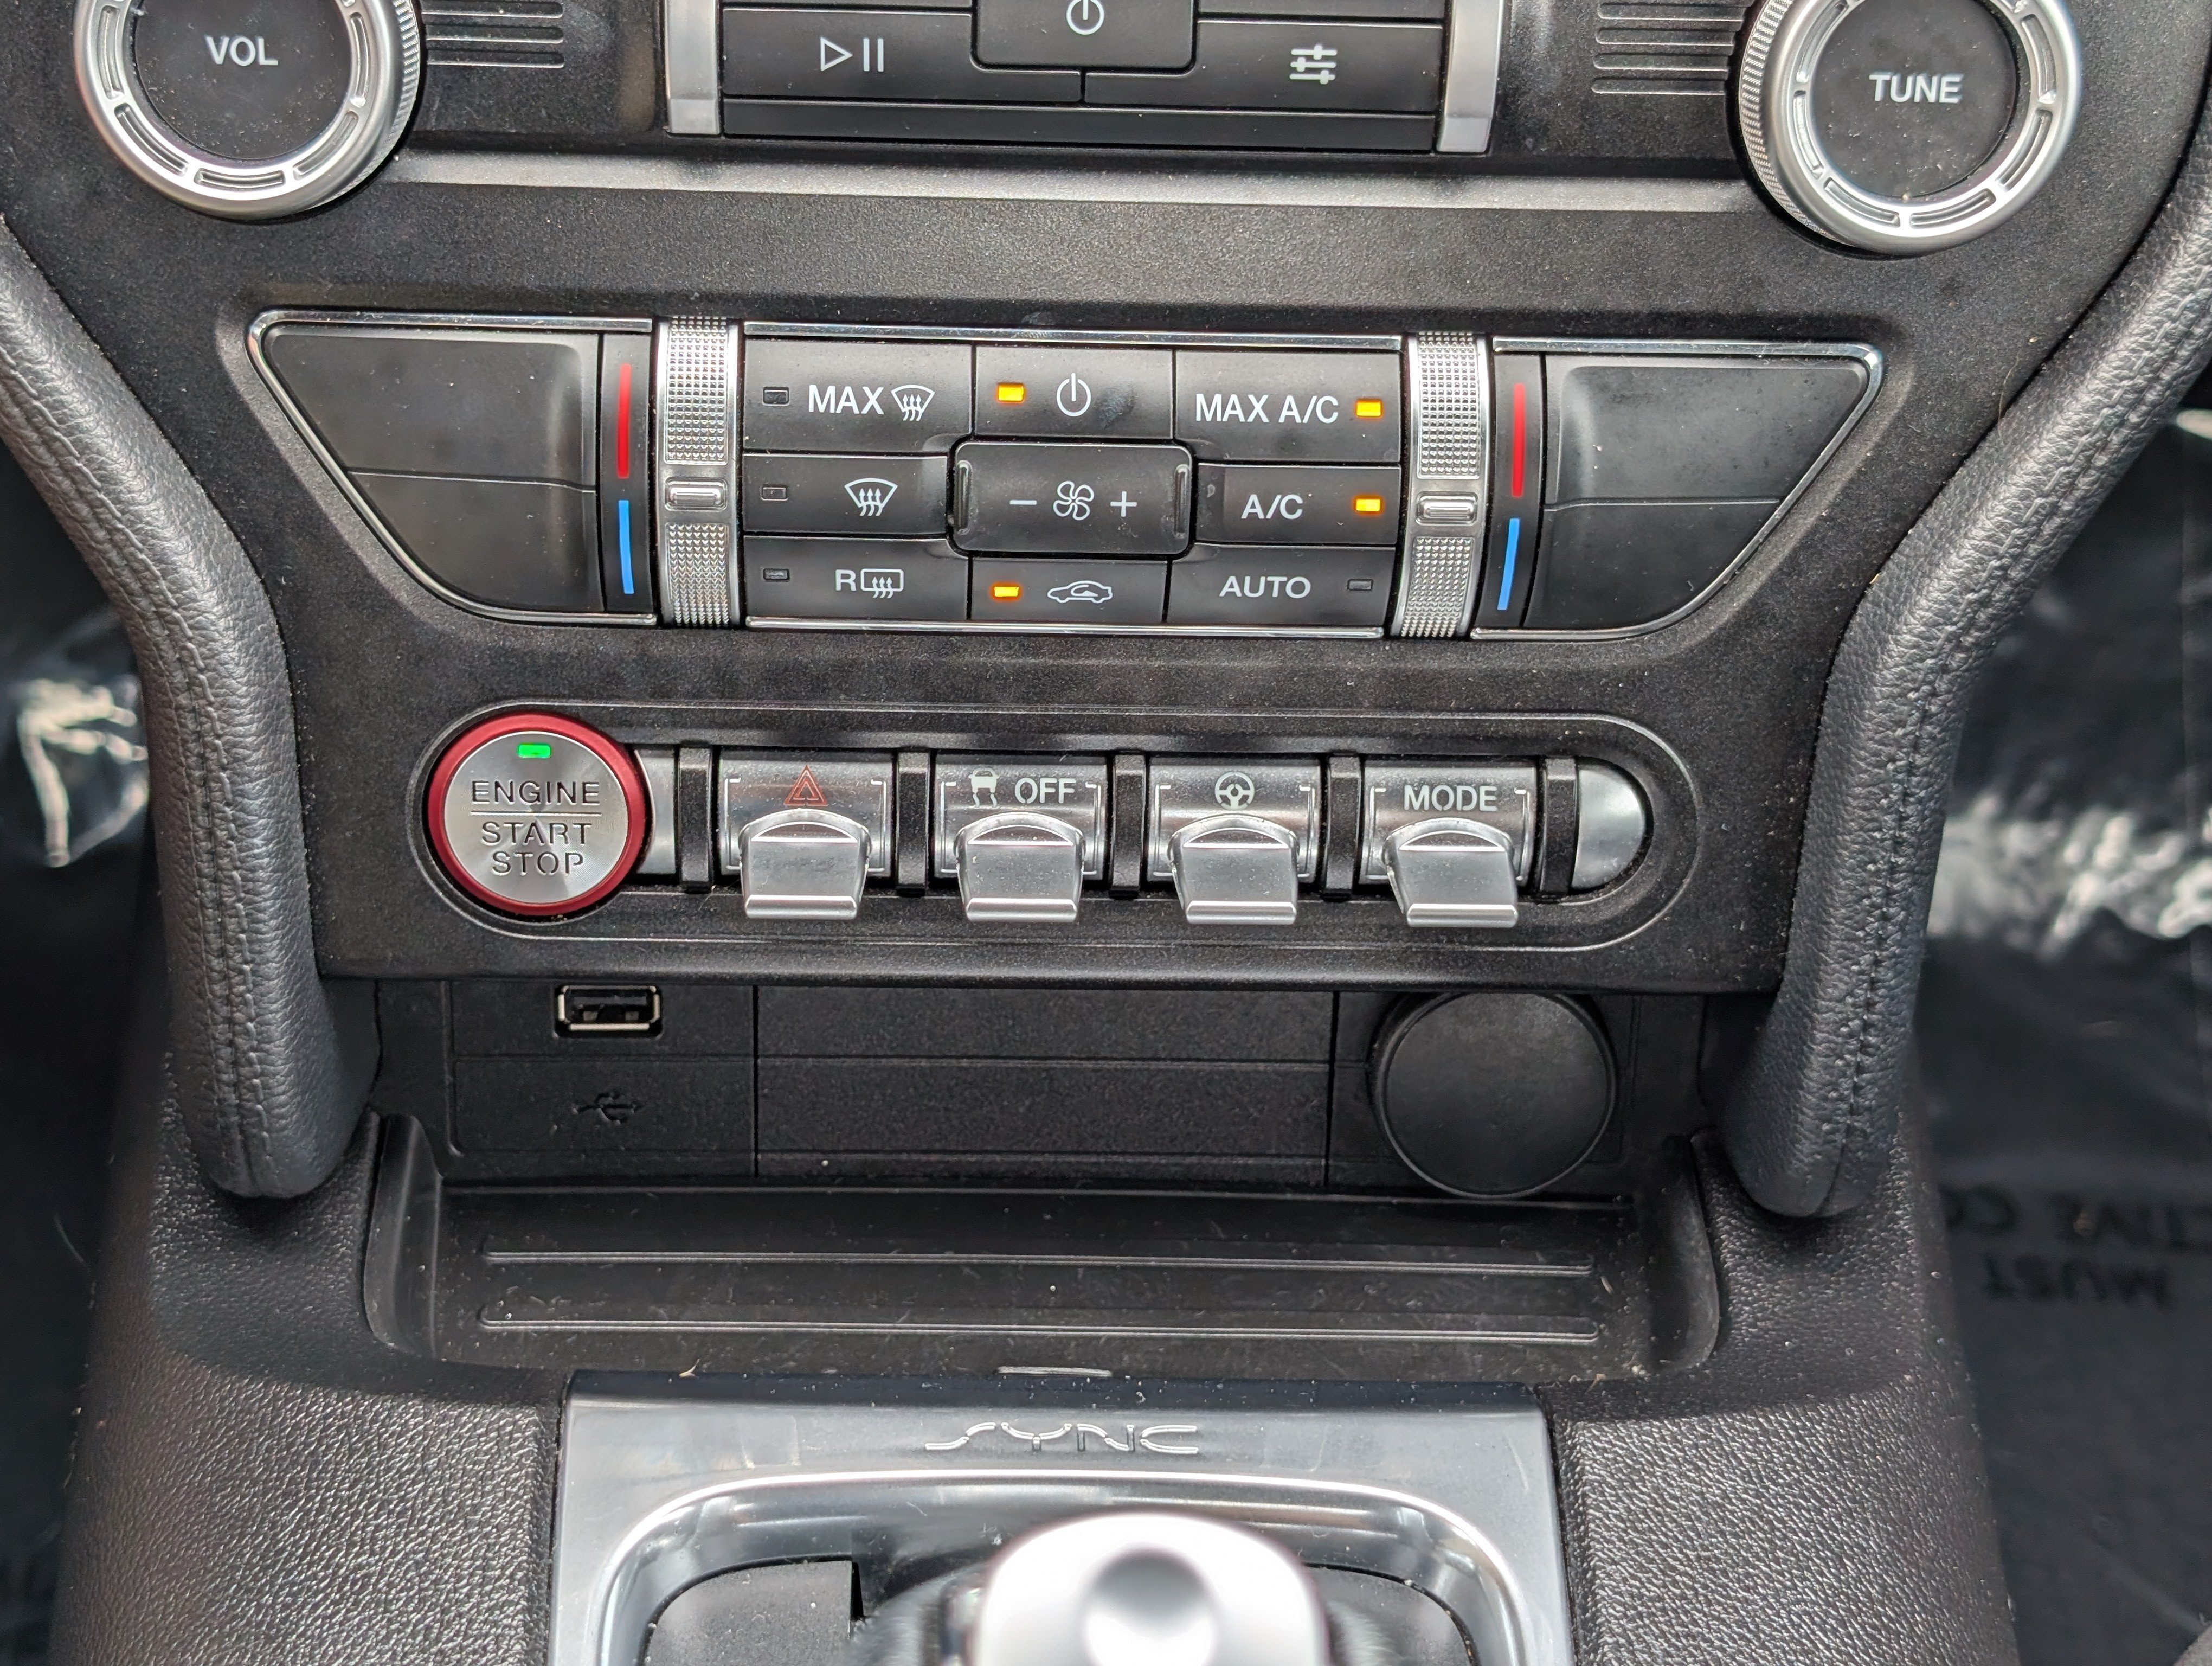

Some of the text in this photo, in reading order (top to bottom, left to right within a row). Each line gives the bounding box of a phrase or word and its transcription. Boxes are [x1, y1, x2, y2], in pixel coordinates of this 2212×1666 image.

[204, 34, 279, 66] VOL
[1868, 71, 1964, 104] TUNE
[808, 384, 884, 415] MAX
[1195, 393, 1339, 424] MAX A/C
[1241, 494, 1304, 520] A/C
[835, 569, 856, 592] R
[1219, 576, 1311, 599] AUTO
[471, 780, 600, 805] ENGINE
[1014, 778, 1076, 804] OFF
[1403, 785, 1499, 812] MODE
[481, 821, 593, 845] START
[492, 851, 584, 876] STOP
[925, 1422, 1199, 1454] SYNC
